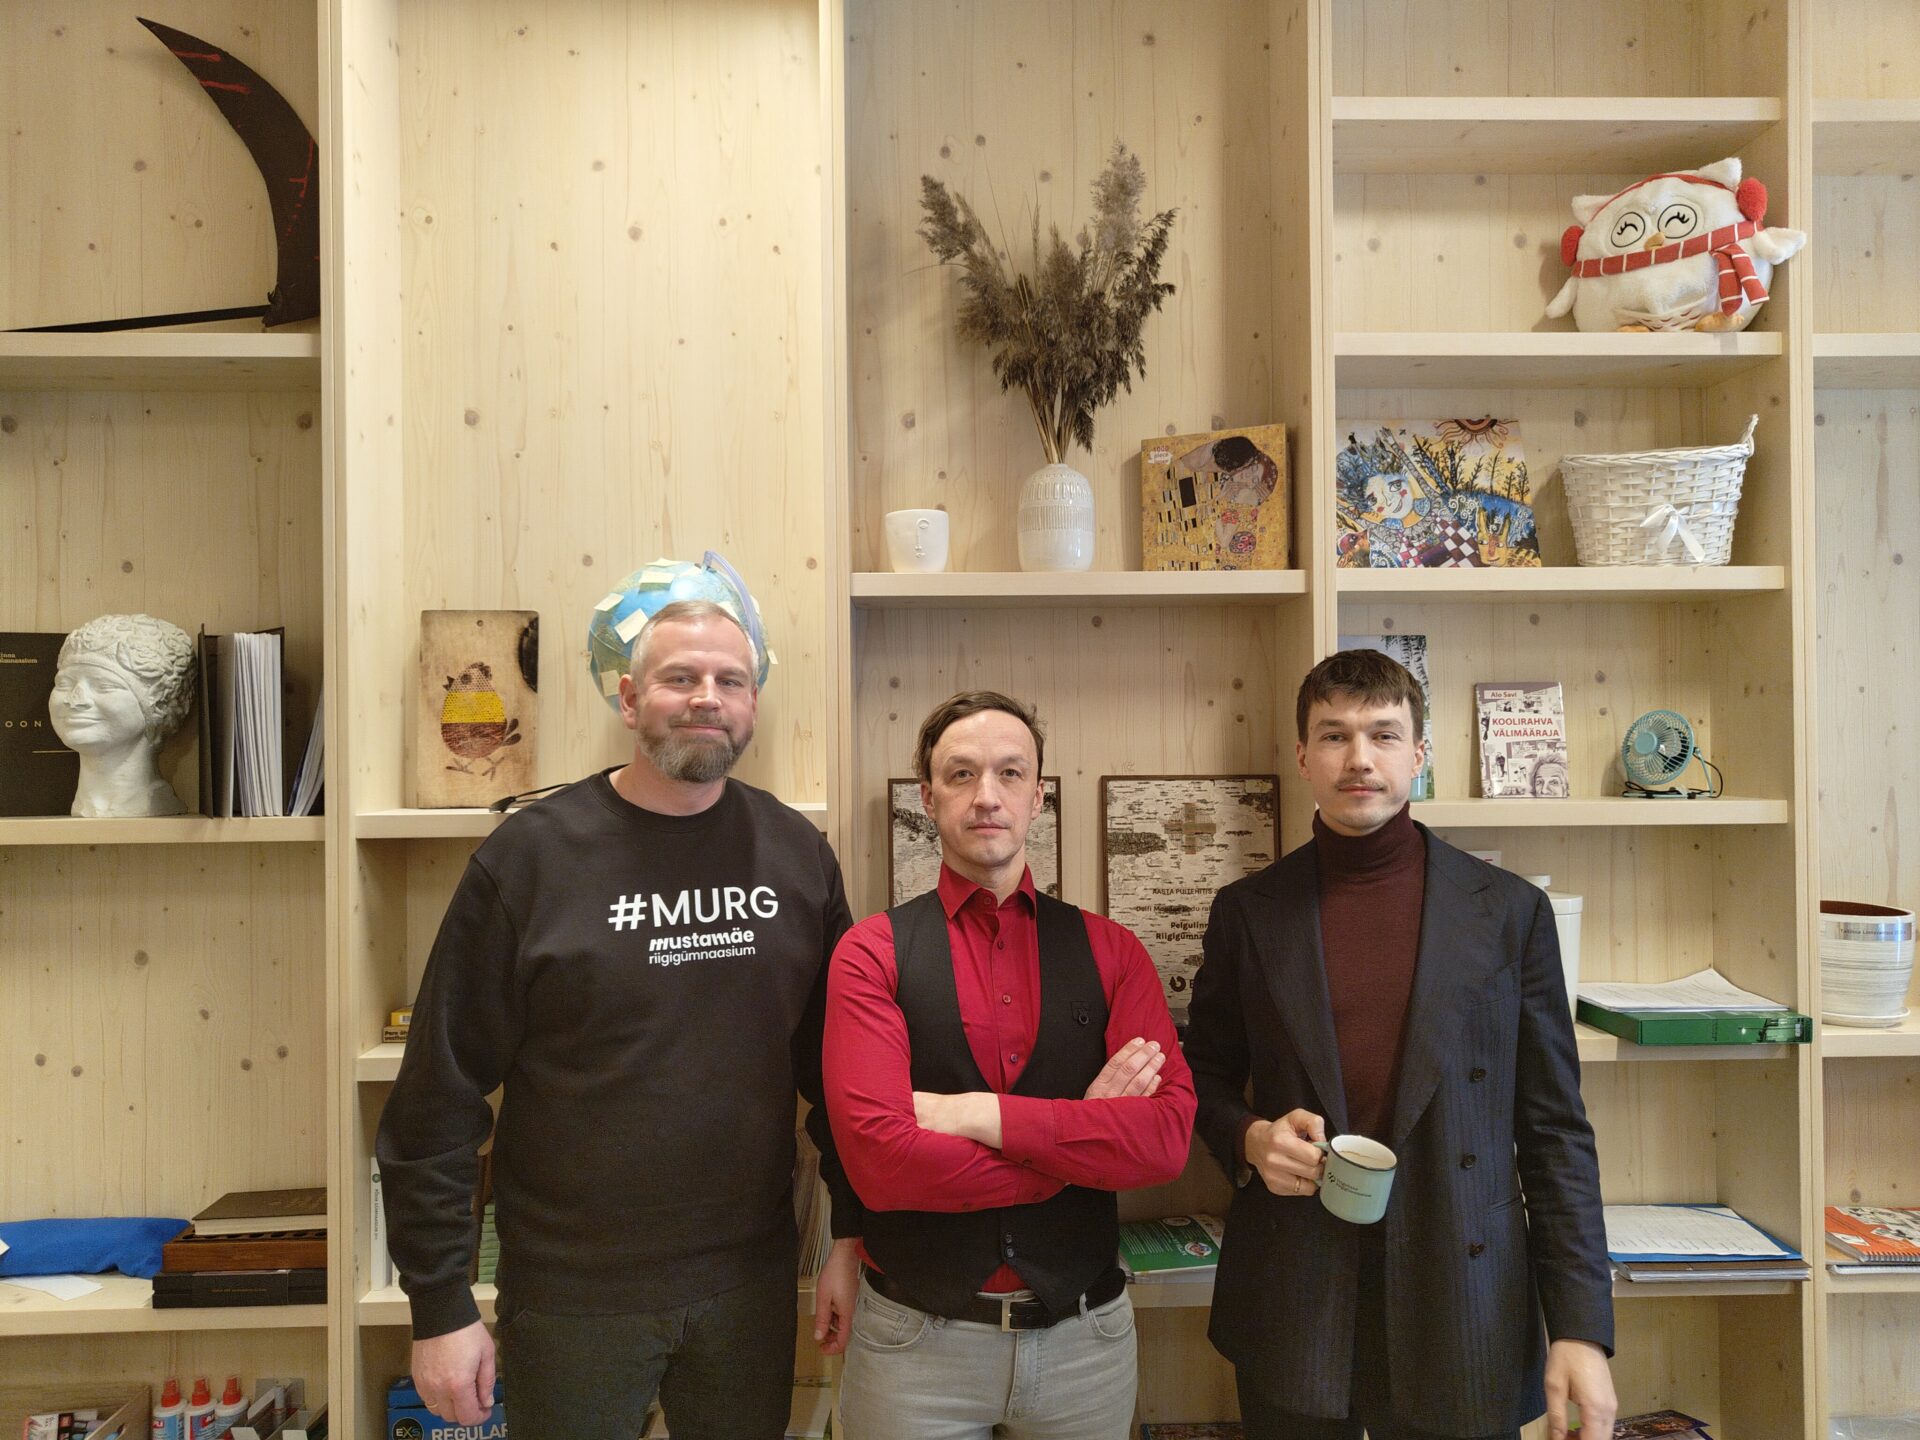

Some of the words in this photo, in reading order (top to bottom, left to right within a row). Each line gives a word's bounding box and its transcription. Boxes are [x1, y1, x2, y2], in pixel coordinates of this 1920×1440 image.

[1492, 717, 1553, 726] KOOLIRAHVA
[1493, 727, 1560, 737] VÄLIMÄÄRAJA
[608, 886, 779, 931] #MURG
[649, 927, 755, 951] mustamäe
[649, 945, 756, 966] riigigümnaasium
